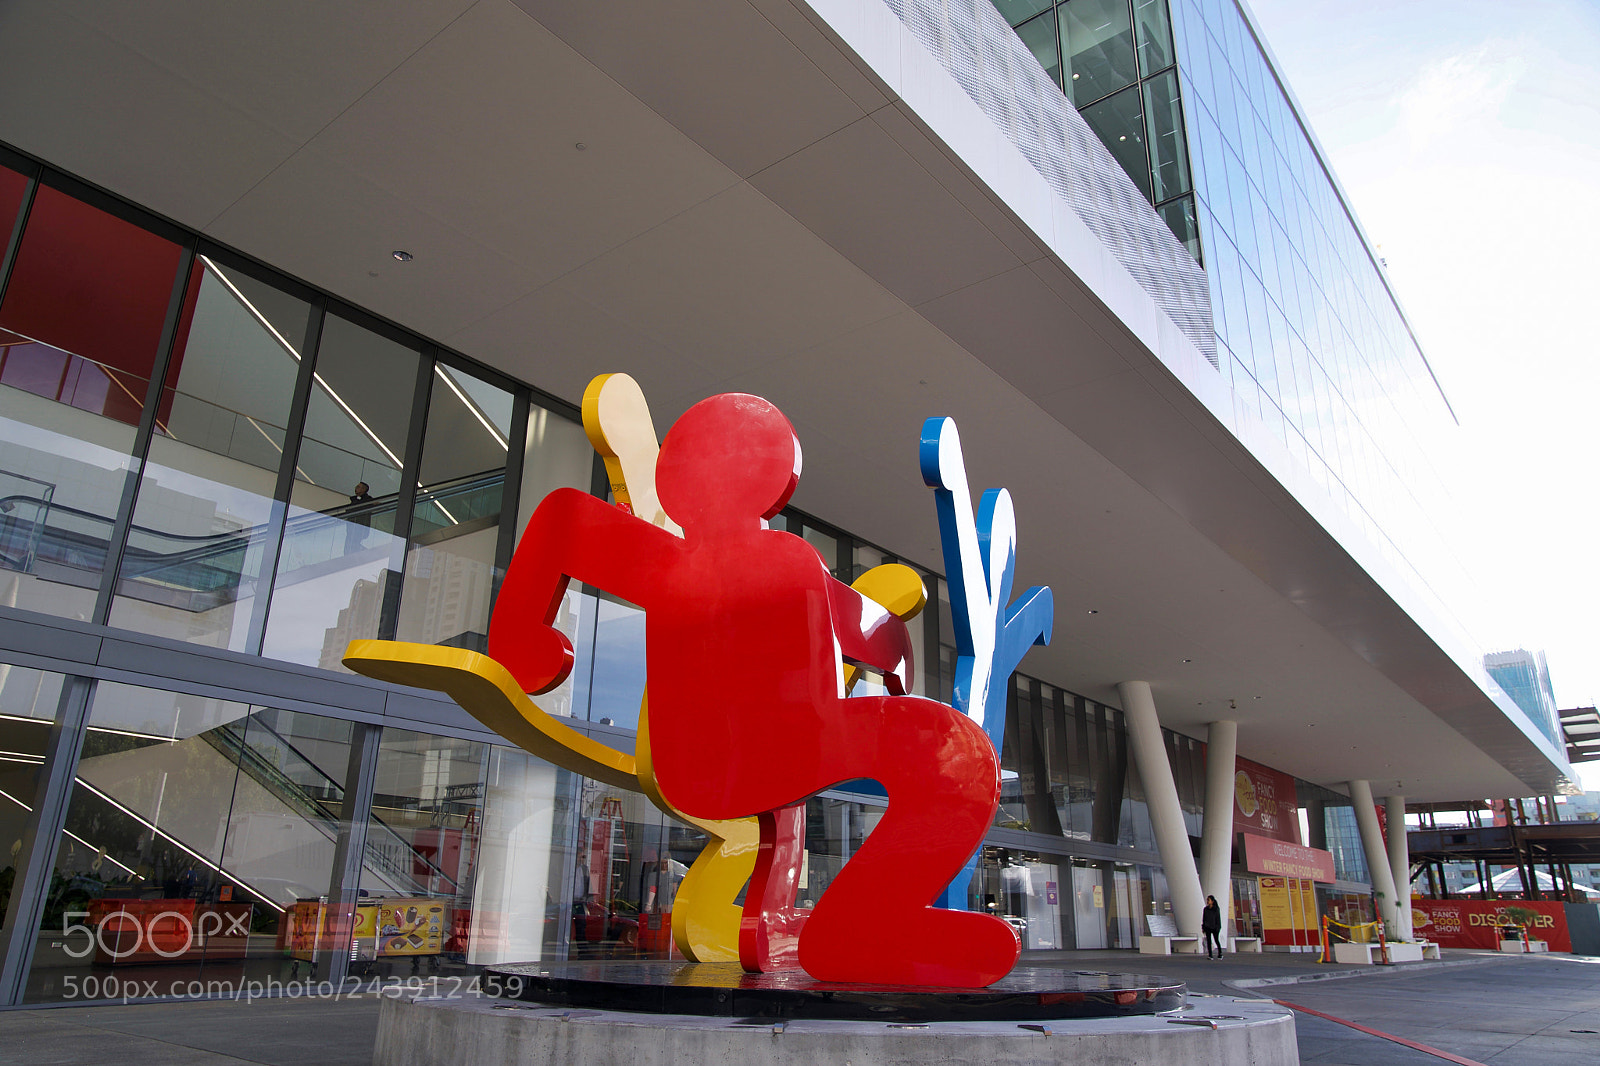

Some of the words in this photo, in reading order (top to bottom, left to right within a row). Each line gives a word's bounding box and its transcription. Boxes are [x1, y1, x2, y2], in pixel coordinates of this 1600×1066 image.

[1259, 796, 1277, 815] FOOD
[1261, 812, 1279, 830] SHOW
[1273, 844, 1298, 859] WELCOME
[1433, 917, 1461, 926] FOOD
